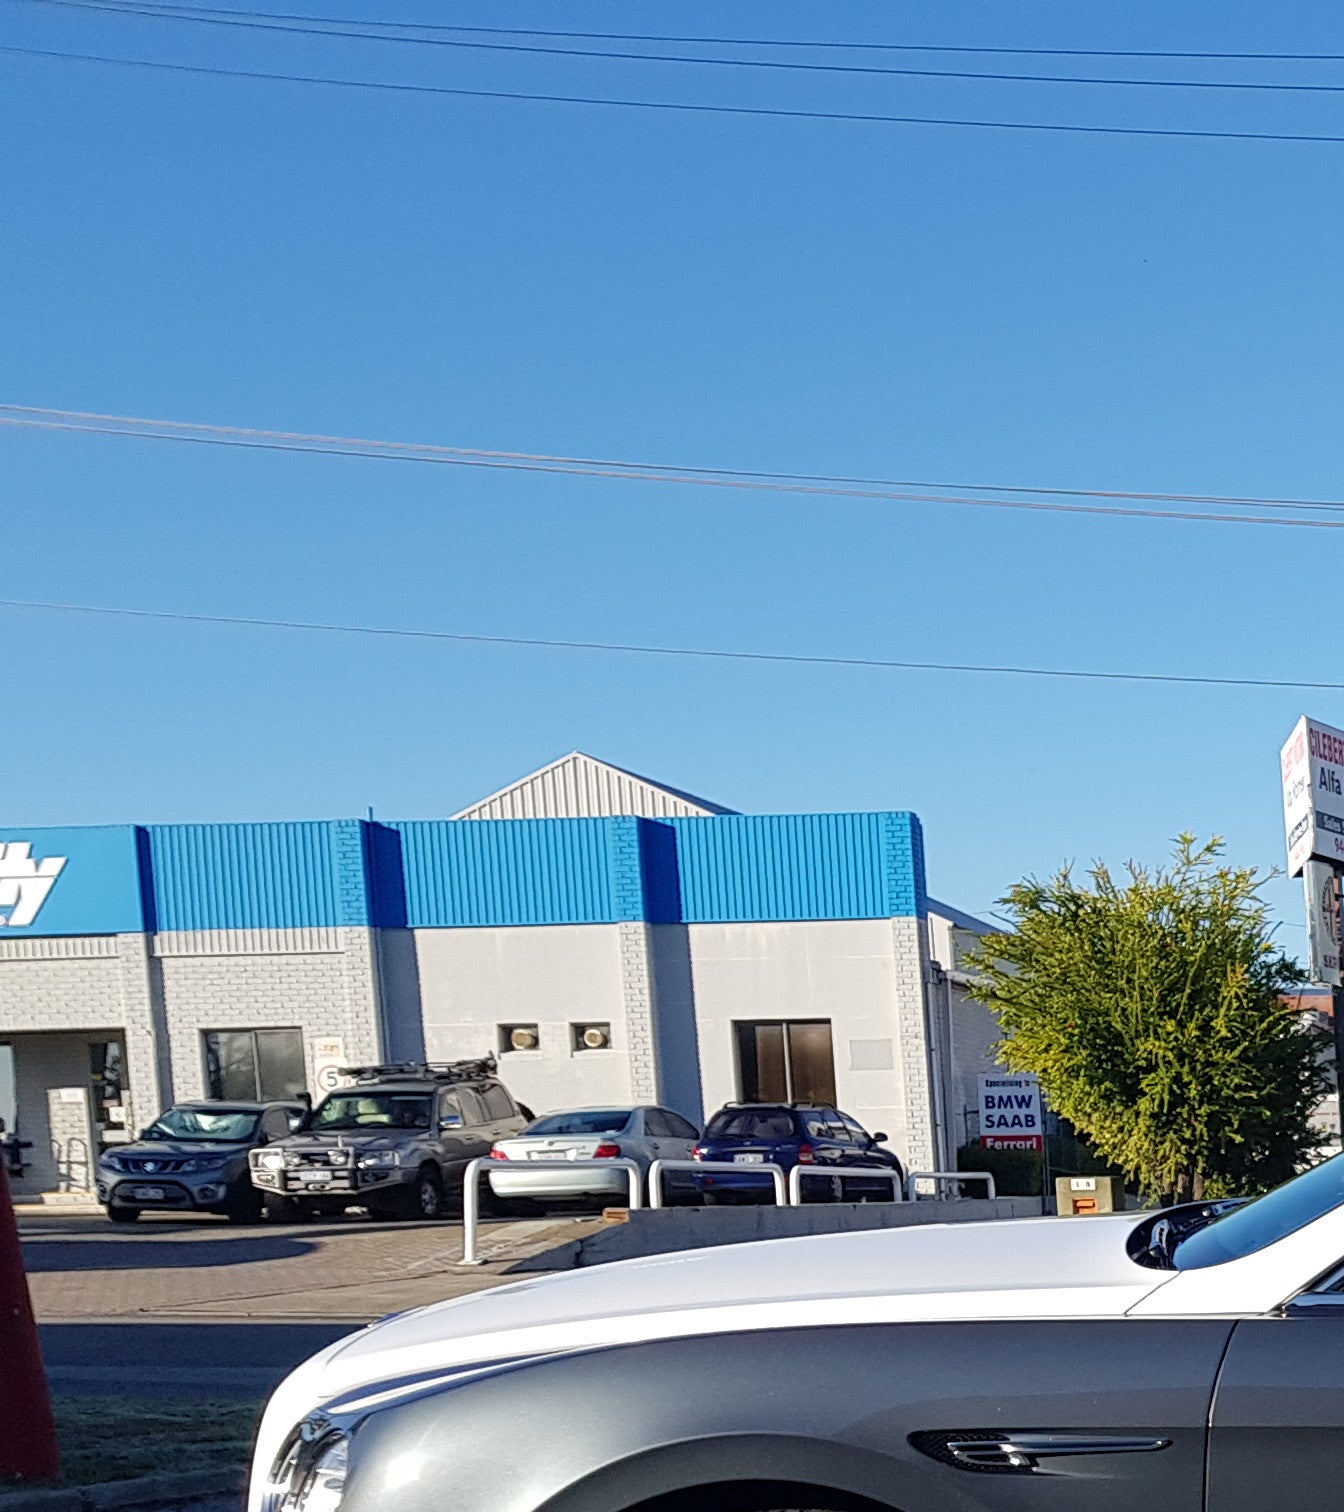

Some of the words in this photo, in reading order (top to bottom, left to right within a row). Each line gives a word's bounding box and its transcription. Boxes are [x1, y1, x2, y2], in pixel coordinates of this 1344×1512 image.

[1318, 767, 1342, 795] Alfa
[327, 1071, 338, 1087] 5
[984, 1095, 1033, 1109] BMW
[985, 1114, 1036, 1128] SAAB
[986, 1137, 1037, 1150] Ferrari
